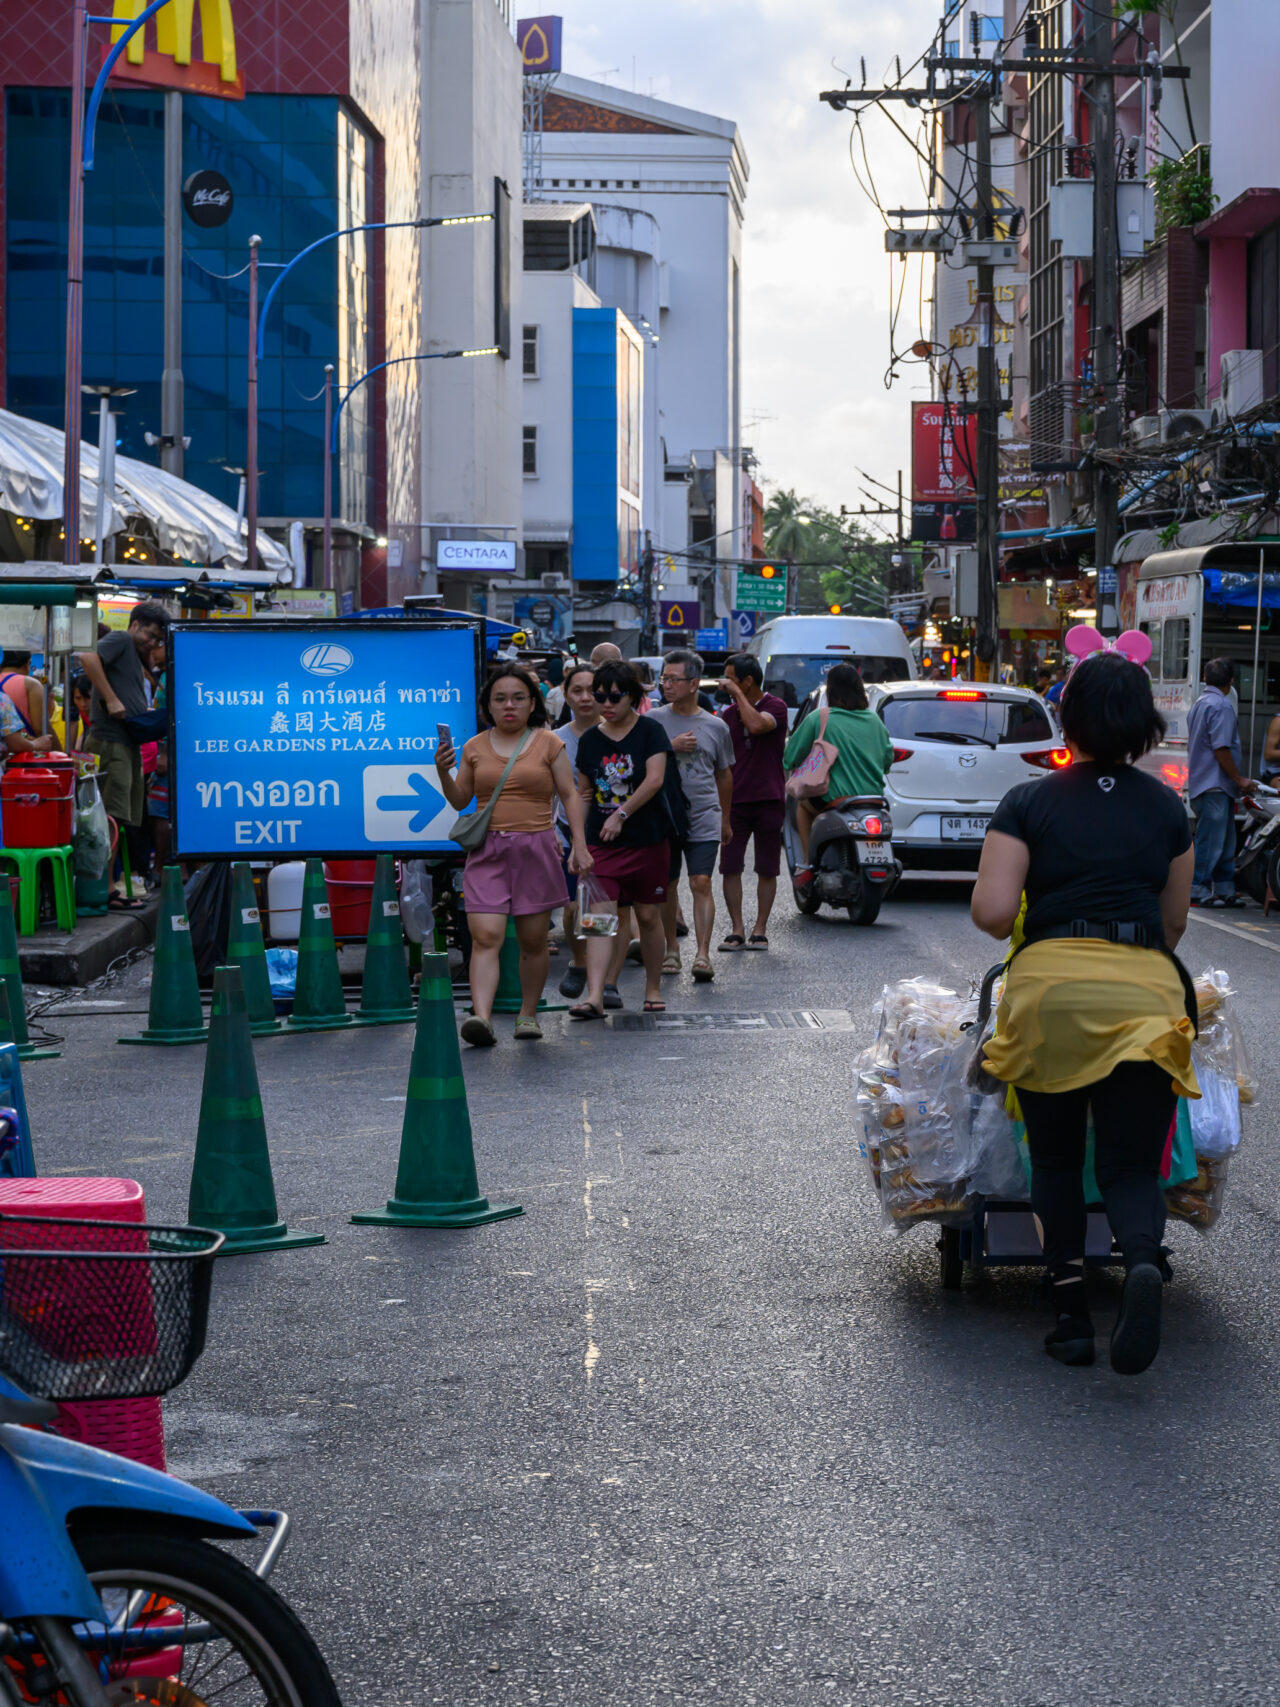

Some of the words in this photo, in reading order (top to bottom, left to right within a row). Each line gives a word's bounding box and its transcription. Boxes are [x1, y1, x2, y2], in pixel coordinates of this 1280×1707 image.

[444, 546, 509, 559] CENTARA
[193, 682, 264, 706] โรงแรม
[276, 681, 290, 705] ลี
[302, 680, 386, 704] การ์เดนส์
[398, 680, 461, 704] พลาซ่า
[194, 739, 229, 753] LEE
[234, 739, 326, 753] GARDENS
[331, 737, 393, 751] PLAZA
[399, 736, 461, 751] HOTL
[195, 779, 340, 809] ทางออก
[234, 819, 303, 845] EXIT
